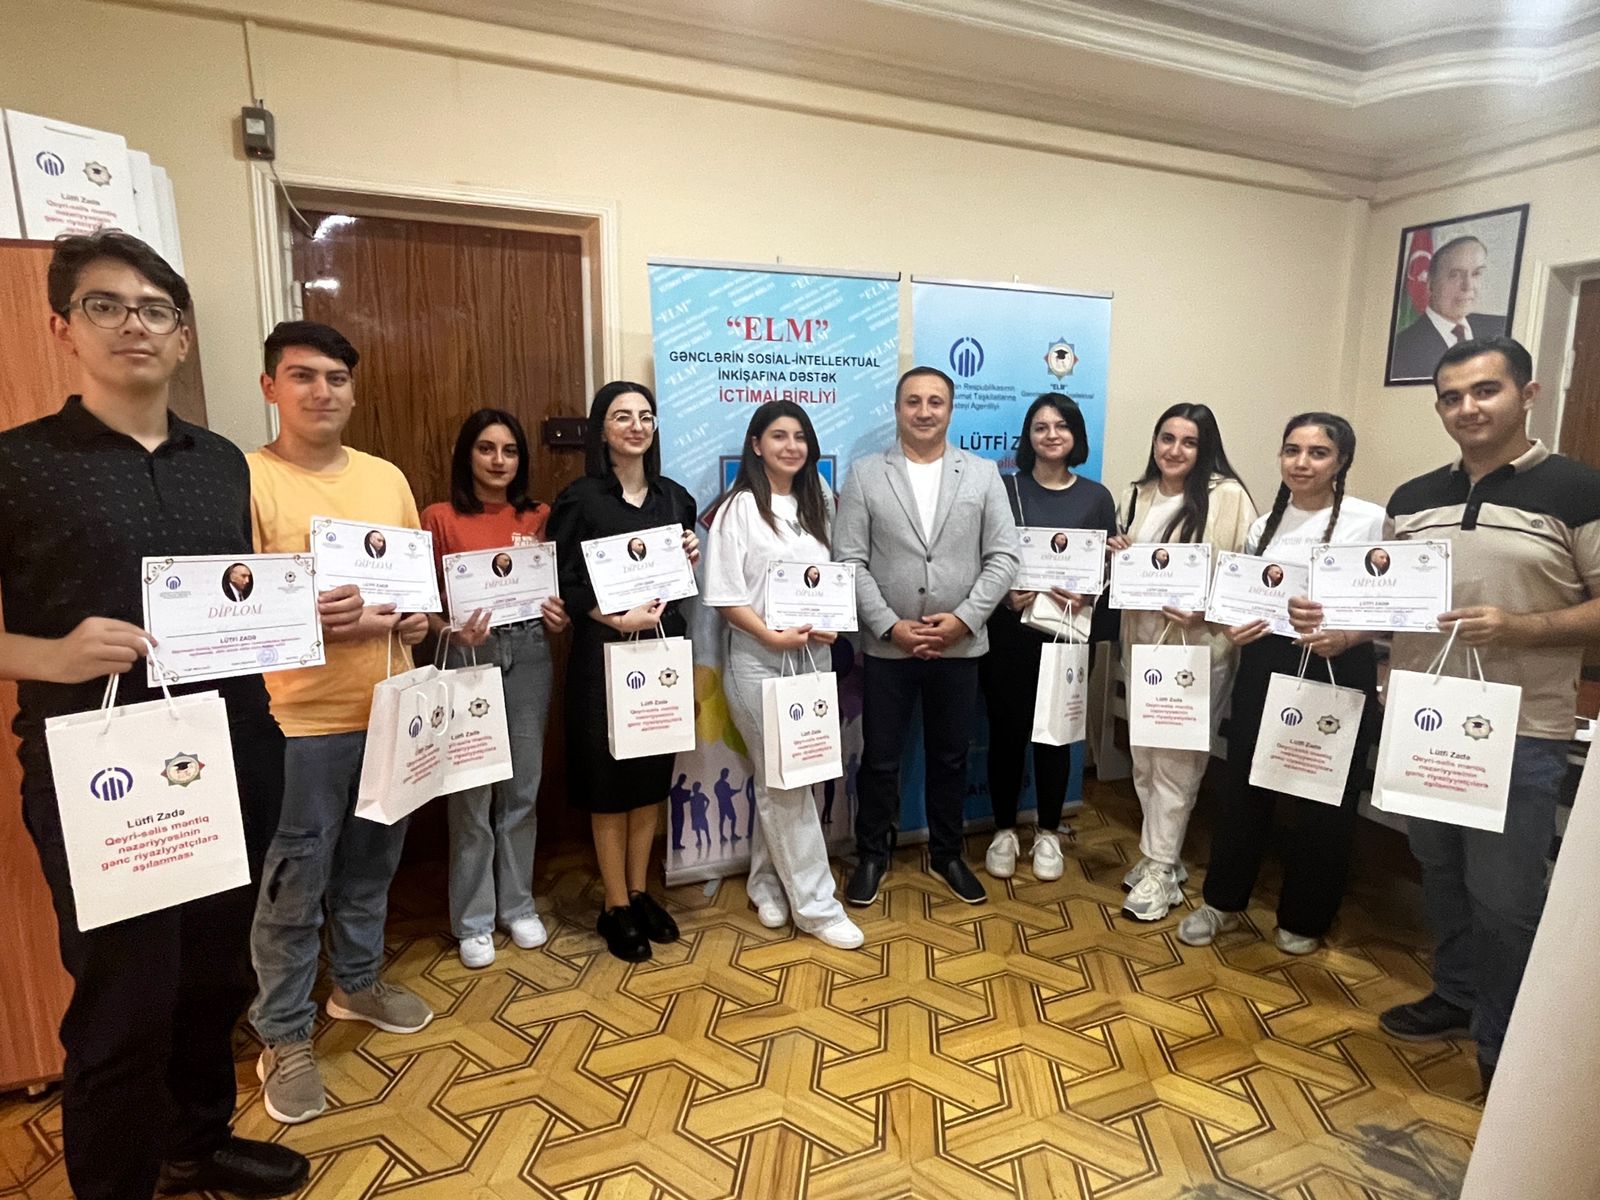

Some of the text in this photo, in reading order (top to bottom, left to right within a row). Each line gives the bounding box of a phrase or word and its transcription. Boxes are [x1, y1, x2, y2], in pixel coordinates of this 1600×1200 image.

[726, 315, 829, 343] “ELM”
[669, 350, 881, 368] GƏNCLƏRİN SOSİAL-İNTELLEKTUAL
[718, 367, 837, 383] İNKİŞAFINA DƏSTƏK
[719, 386, 836, 404] İCTİMAİ BİRLİYİ
[960, 432, 1007, 451] LÜTFİ
[208, 603, 262, 618] DİPLOM
[126, 809, 186, 829] Lütfi Zadə
[104, 815, 210, 847] Qeyri-səlis məntiq
[118, 827, 201, 854] nəzəriyyəsinin
[101, 834, 219, 871] gənc riyaziyyatçılara
[132, 851, 194, 872] aşılanması
